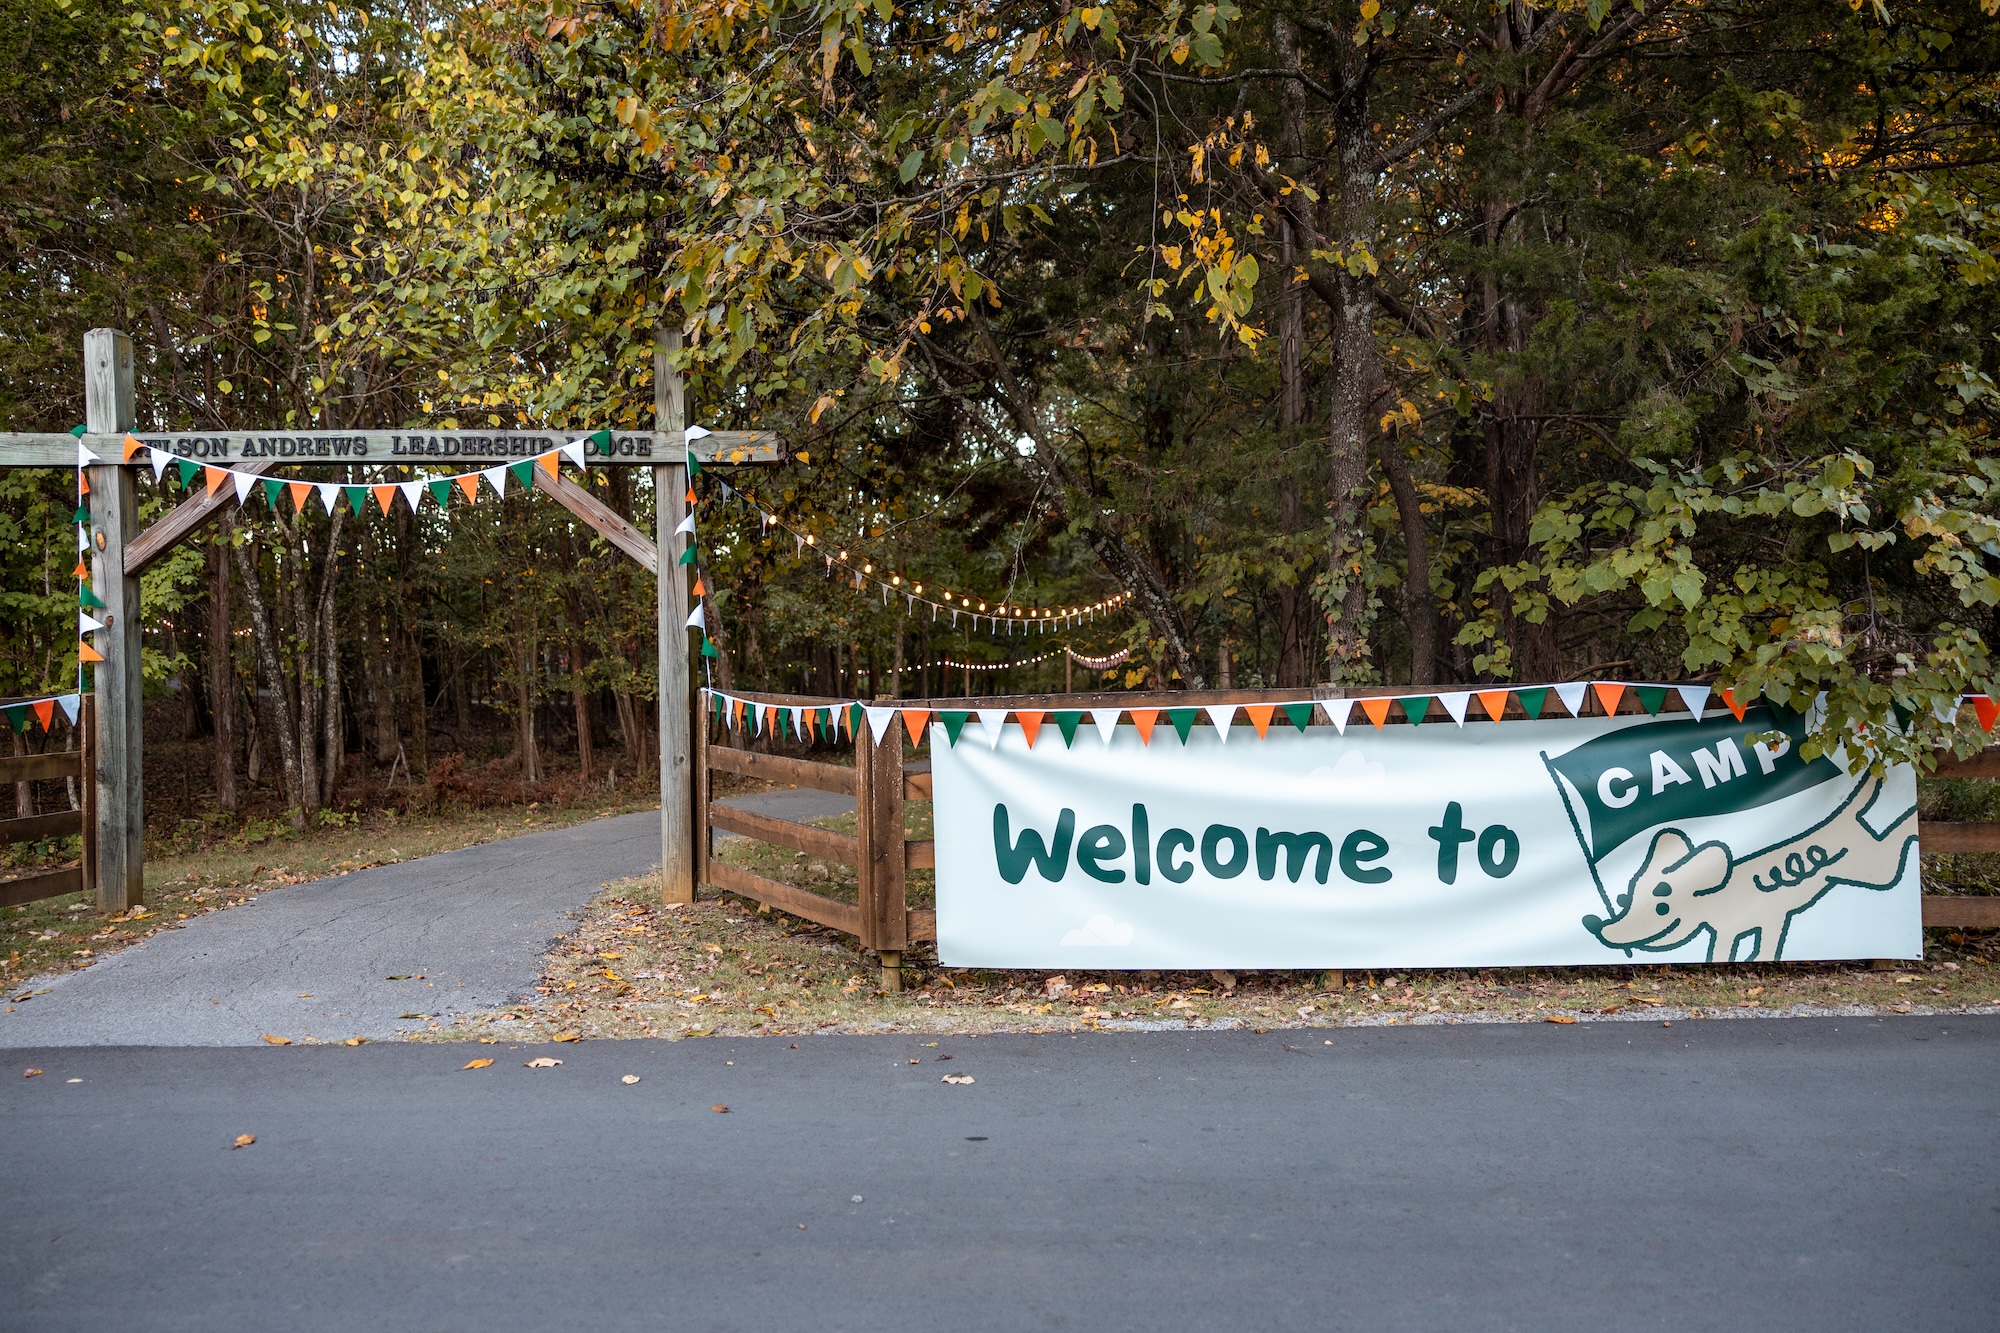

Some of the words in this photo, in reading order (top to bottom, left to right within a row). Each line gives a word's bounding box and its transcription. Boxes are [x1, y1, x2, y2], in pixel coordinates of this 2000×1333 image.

[133, 437, 229, 457] ELSON
[241, 436, 368, 456] ANDREWS
[391, 435, 553, 456] LEADERSHIP
[565, 436, 651, 456] OGE
[1596, 730, 1791, 809] CAMP
[993, 803, 1393, 885] Welcome
[1427, 801, 1520, 885] to
